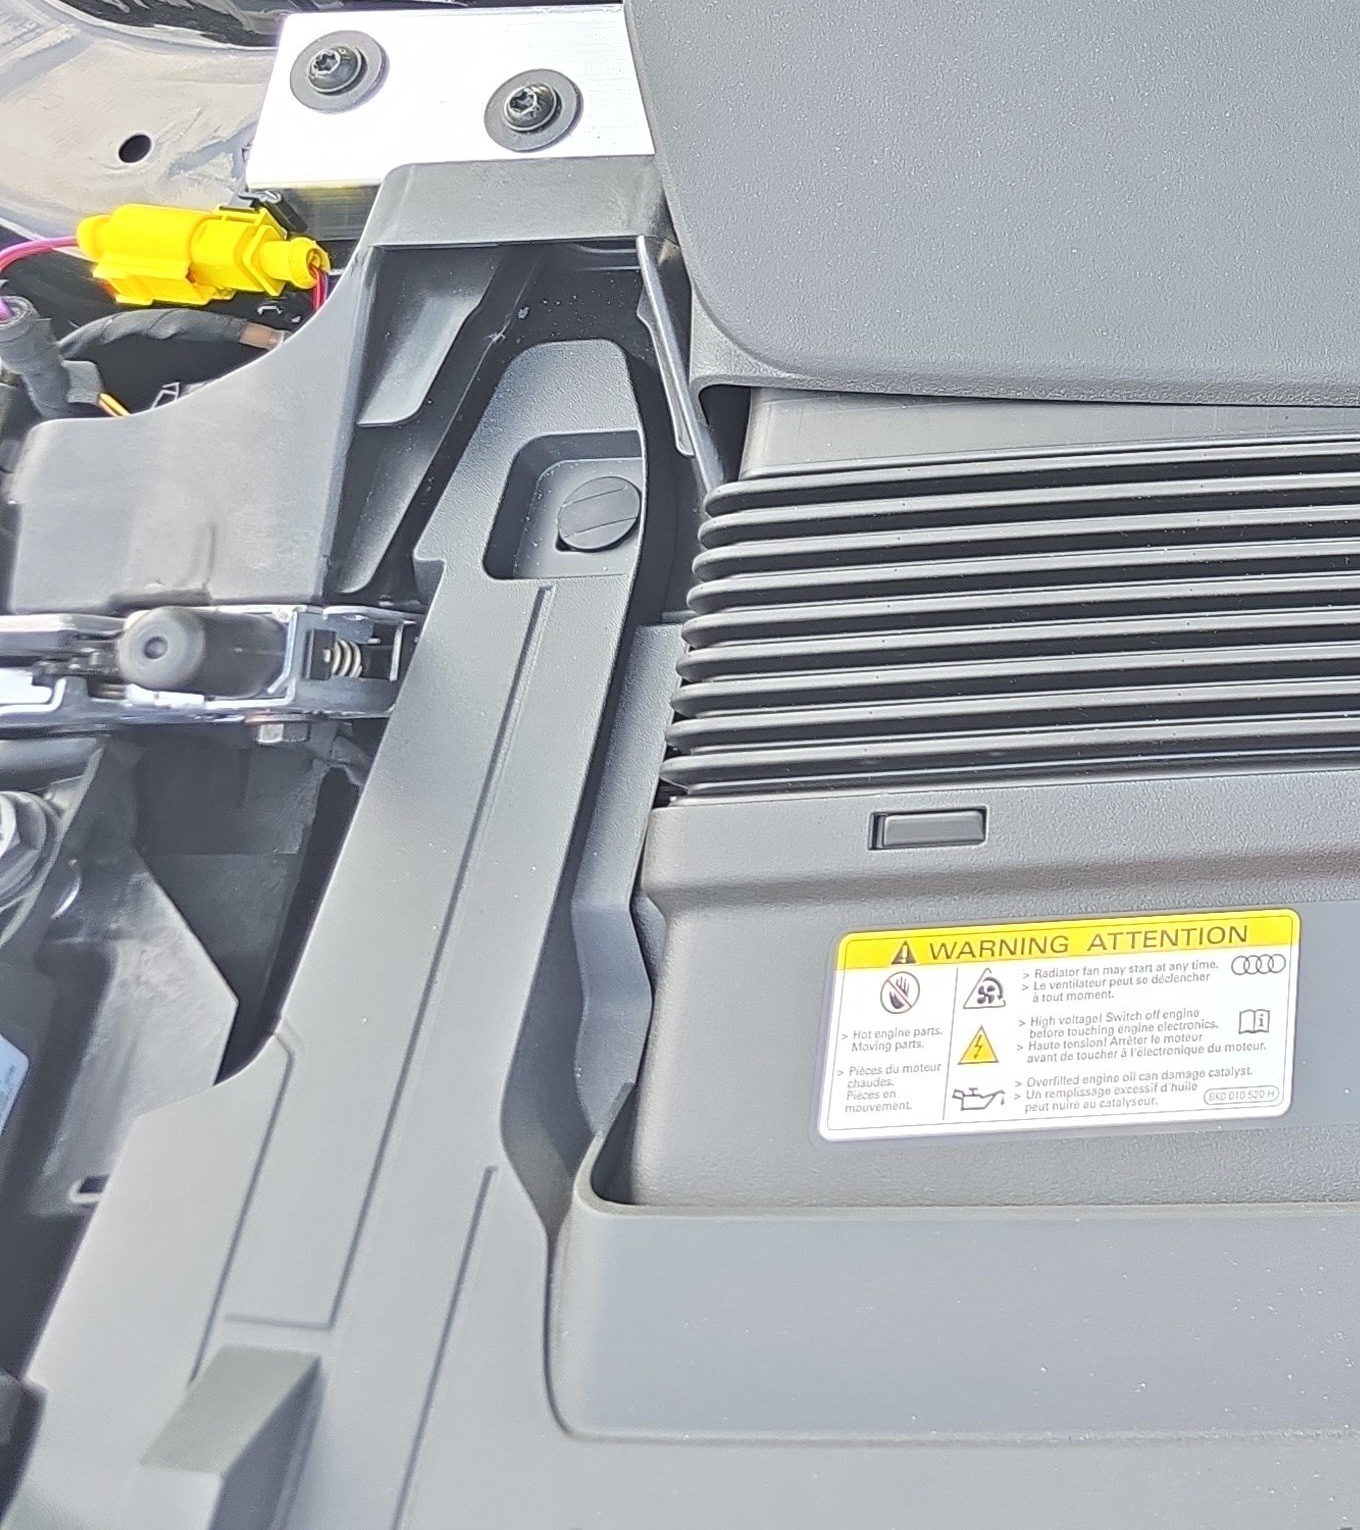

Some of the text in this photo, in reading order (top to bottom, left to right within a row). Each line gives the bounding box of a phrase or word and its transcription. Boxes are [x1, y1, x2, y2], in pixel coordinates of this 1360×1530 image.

[929, 924, 1247, 960] WARNING ATTENTION
[1034, 959, 1218, 979] Radiator fan may start at any time.
[1032, 971, 1210, 991] Le ventilateur peut se déclencher
[1041, 992, 1063, 1002] tout
[1066, 987, 1114, 1001] moment.
[1030, 1015, 1055, 1030] High
[1105, 1010, 1142, 1024] Switch
[1144, 1008, 1160, 1020] off
[1162, 1007, 1199, 1022] engine
[853, 1027, 943, 1041] Hot engine parts.
[1029, 1018, 1218, 1041] before touching engine electronics.
[851, 1036, 924, 1052] Moving parts.
[1028, 1040, 1060, 1051] Haute
[1109, 1033, 1148, 1048] Arrêter
[1150, 1033, 1160, 1044] le
[1163, 1033, 1202, 1045] moteur
[1027, 1049, 1057, 1063] avant
[1059, 1048, 1073, 1061] de
[1076, 1047, 1118, 1060] toucher
[1207, 1042, 1221, 1053] du
[1224, 1042, 1266, 1052] moteur.
[885, 1063, 899, 1074] du
[902, 1063, 941, 1073] moteur
[1026, 1065, 1252, 1087] Overfilled engine oil can damage catalyst.
[882, 1090, 896, 1099] en
[1026, 1079, 1197, 1100] Un remplissage excessif d'huile
[1024, 1096, 1158, 1114] peut nuire au catalyseur.
